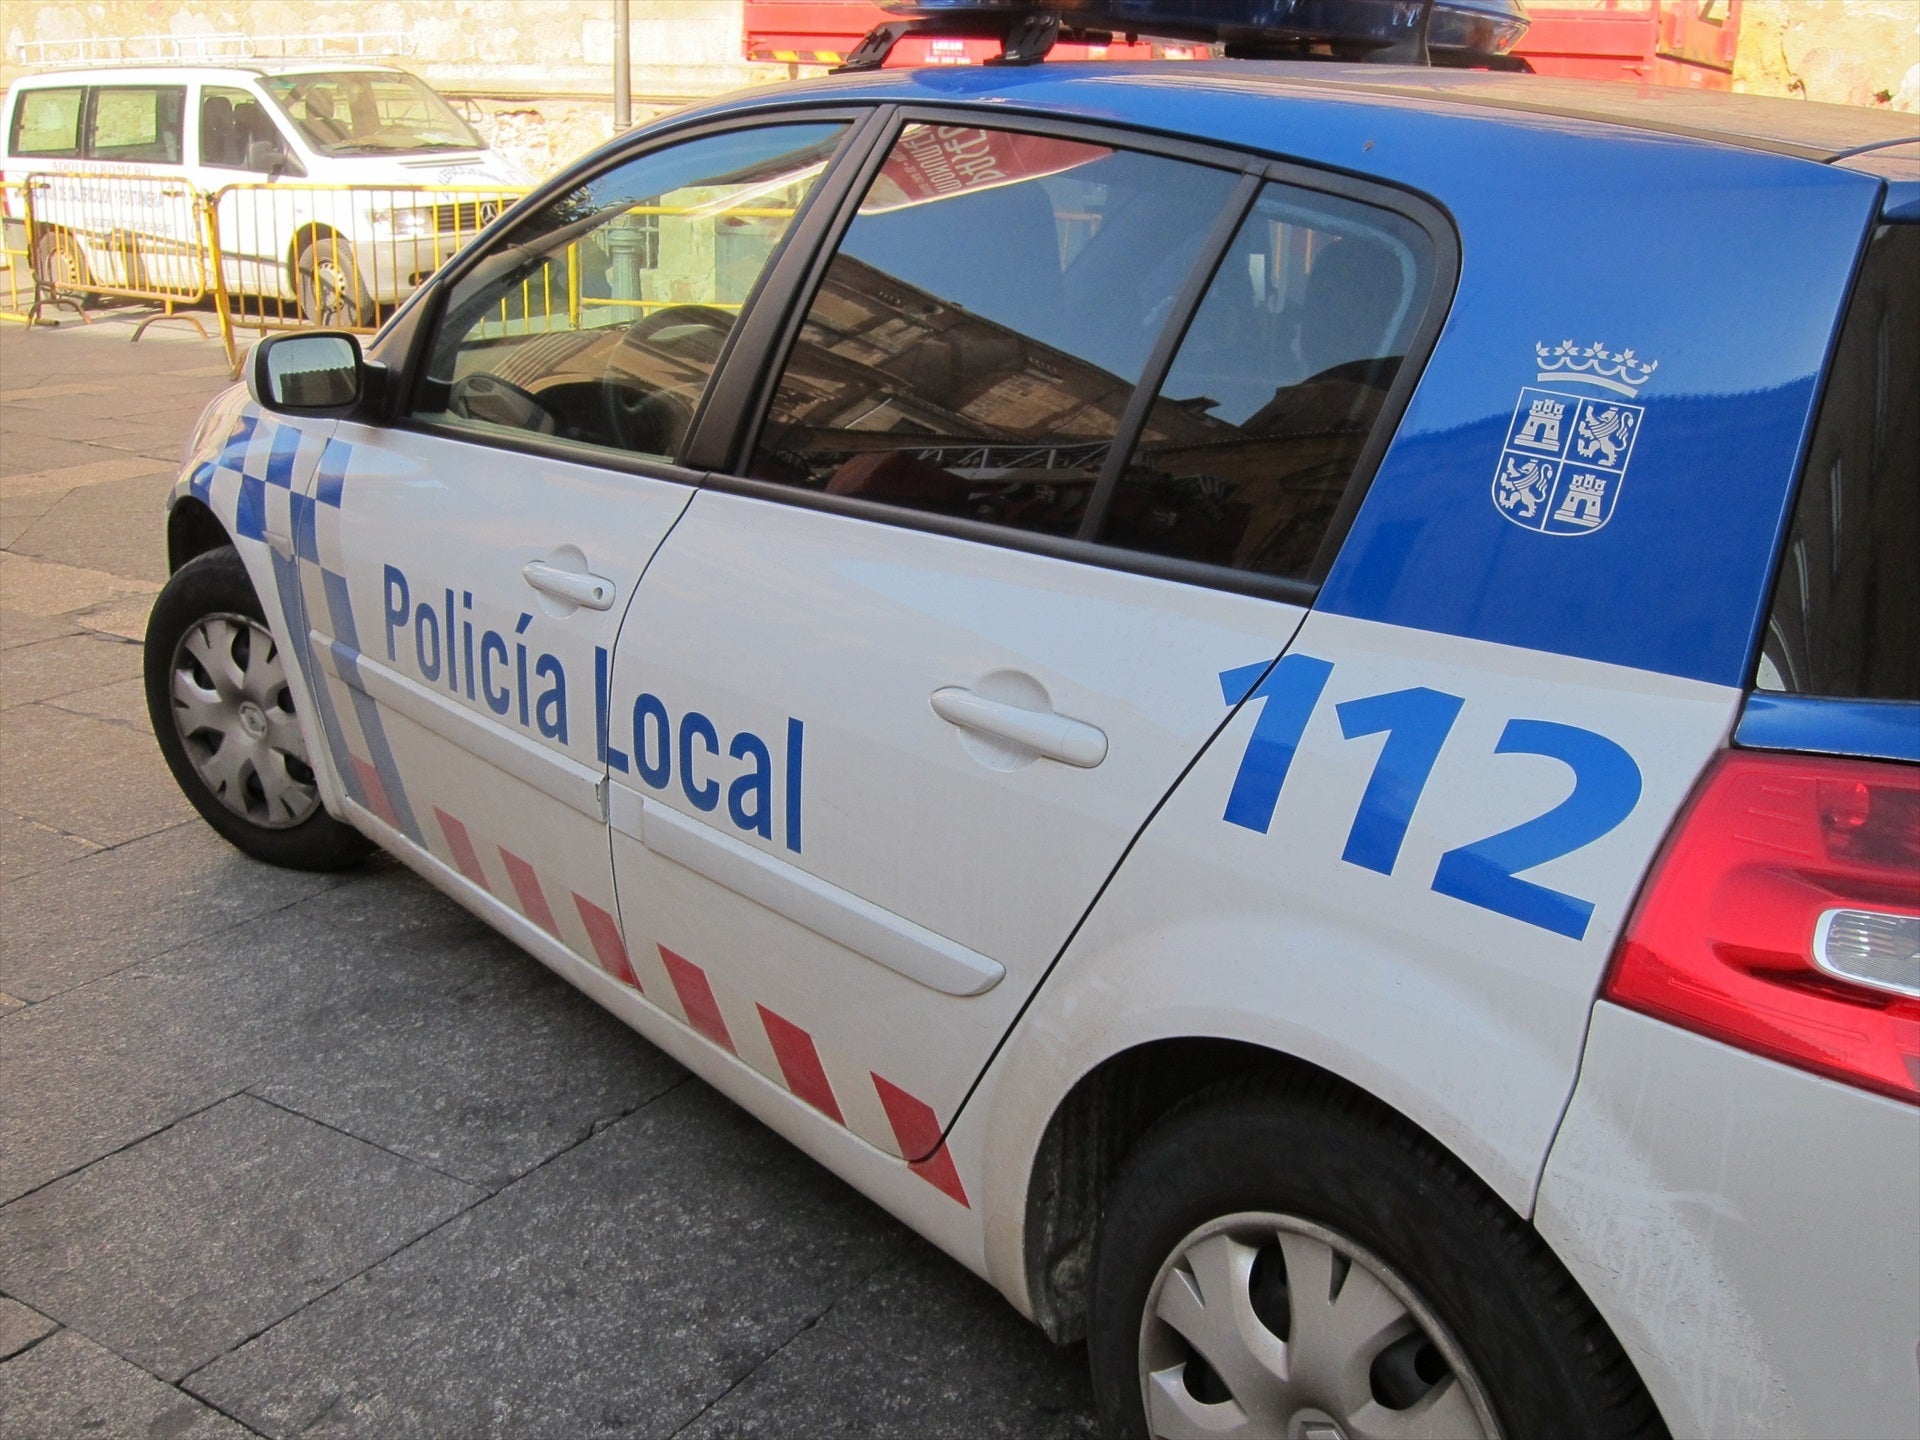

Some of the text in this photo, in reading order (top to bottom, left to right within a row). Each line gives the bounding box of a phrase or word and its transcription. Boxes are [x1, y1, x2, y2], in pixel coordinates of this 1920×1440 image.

[384, 564, 804, 854] Policía Local
[1218, 653, 1643, 942] 112
